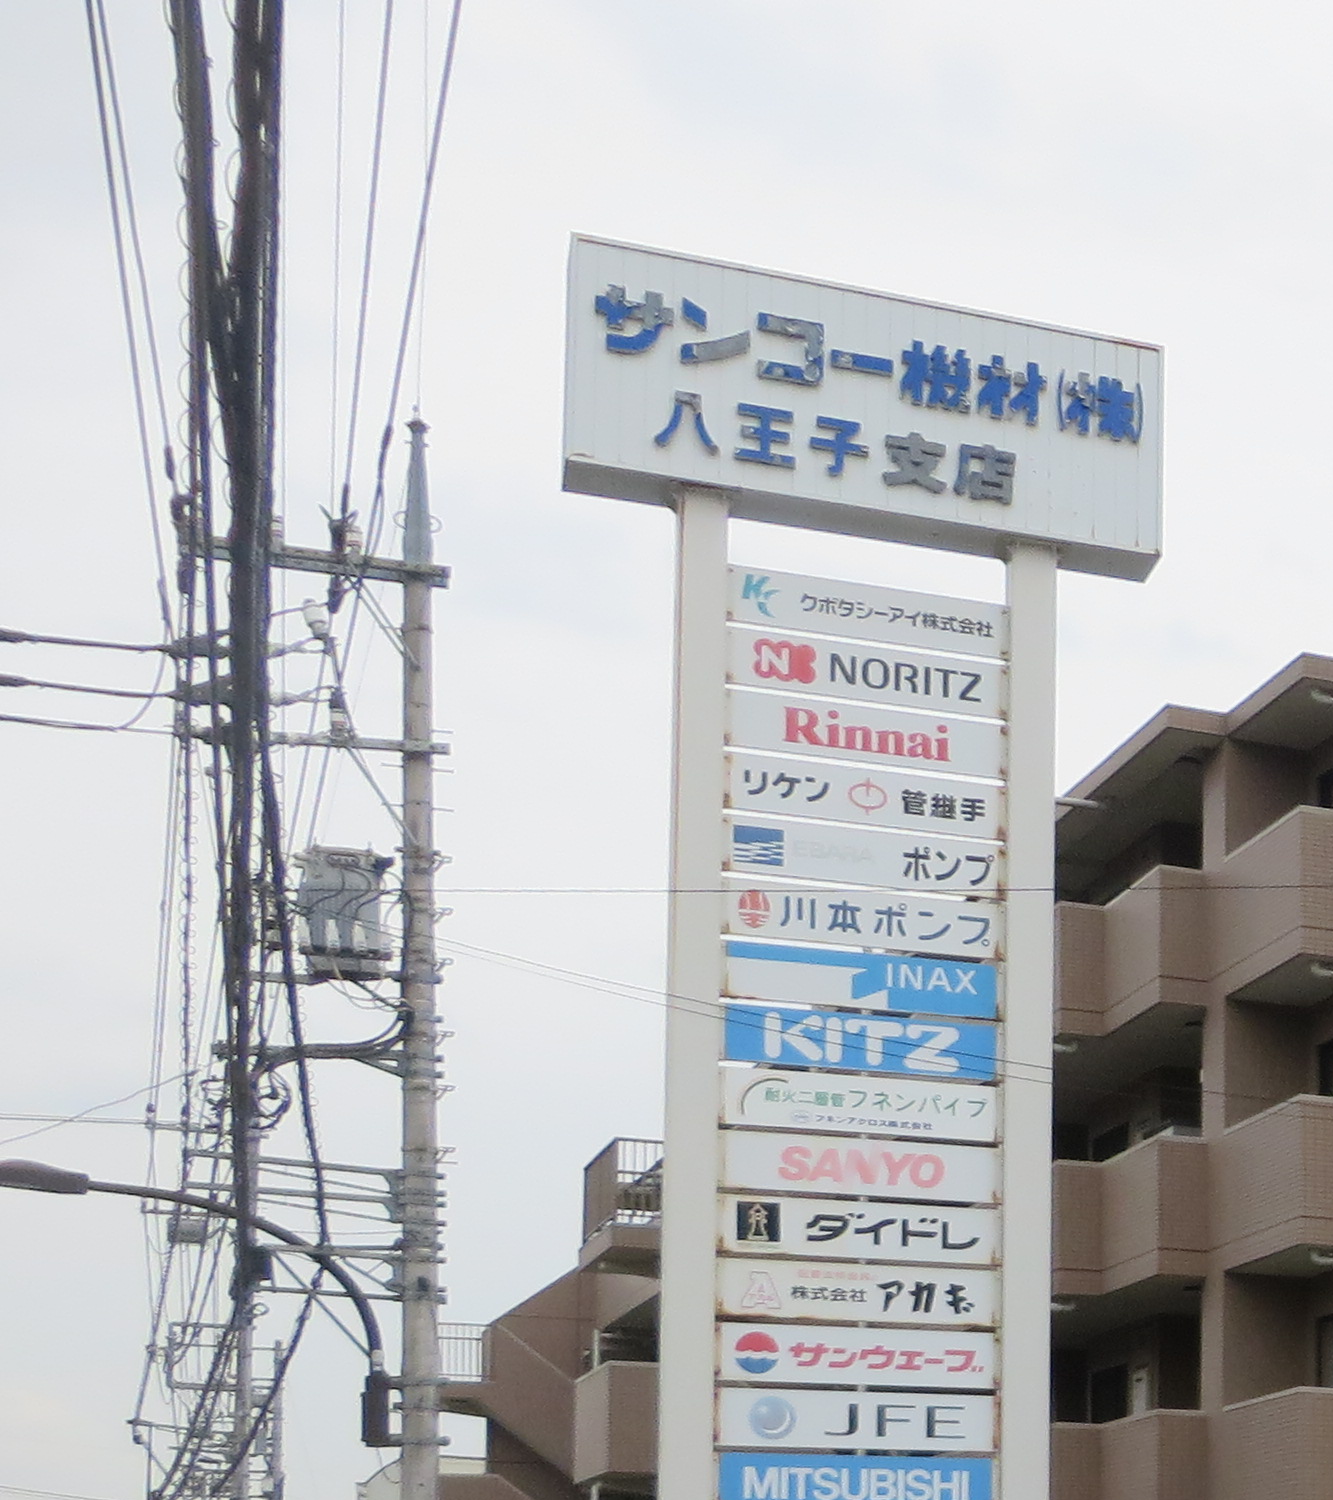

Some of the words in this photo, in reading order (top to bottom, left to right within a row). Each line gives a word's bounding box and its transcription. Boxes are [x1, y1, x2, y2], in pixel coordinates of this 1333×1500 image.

[654, 390, 1017, 506] 八王子支店
[799, 593, 995, 638] クボタシーアイ株式会社
[829, 652, 982, 702] NORITZ
[782, 706, 951, 762] Rinnai
[743, 769, 830, 802] リケン
[901, 789, 986, 822] 管継手
[902, 846, 995, 886] ポンプ
[780, 895, 991, 947] 川本ポンプ
[884, 963, 979, 995] INAX
[763, 1011, 960, 1073] KITZ
[778, 1145, 945, 1189] SANYO
[806, 1212, 980, 1250] ダイドレ
[791, 1285, 868, 1302] 株式会社
[824, 1403, 967, 1439] JFE
